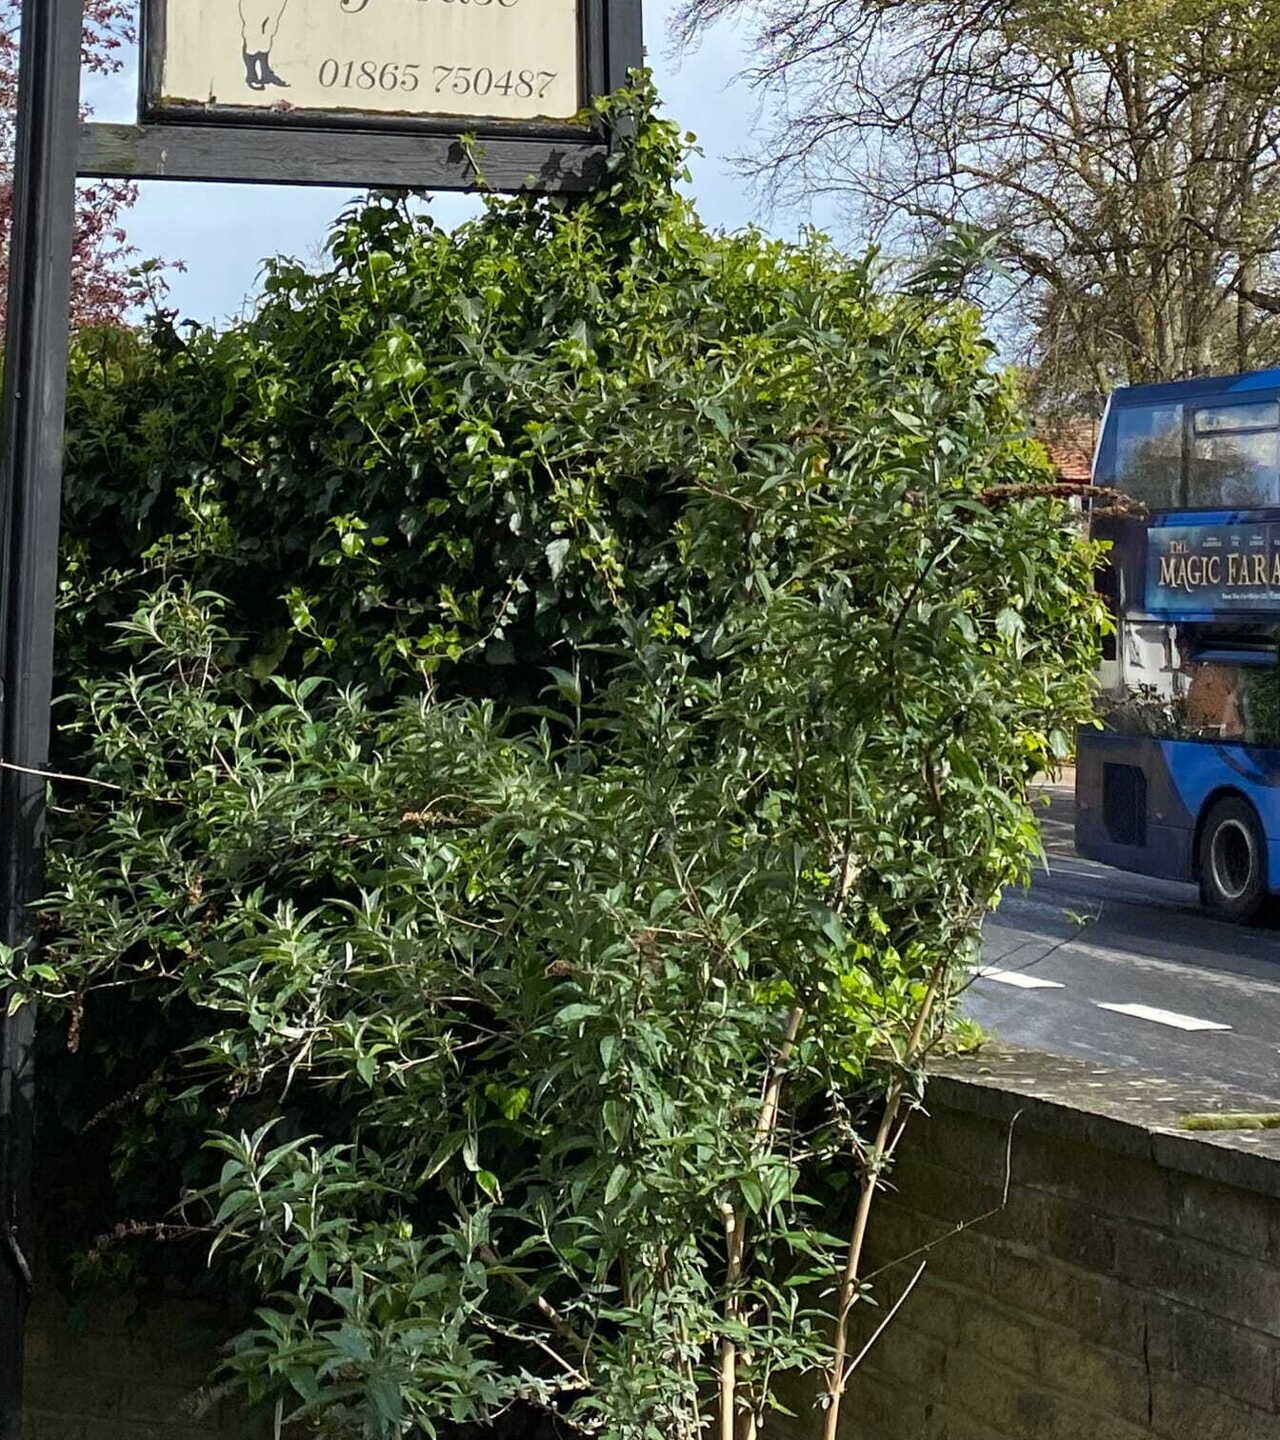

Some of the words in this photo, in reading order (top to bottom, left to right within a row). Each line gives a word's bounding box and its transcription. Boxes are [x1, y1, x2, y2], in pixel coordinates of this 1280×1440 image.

[318, 58, 422, 93] 01865
[432, 64, 558, 100] 750487
[1158, 555, 1221, 593] MAGIC
